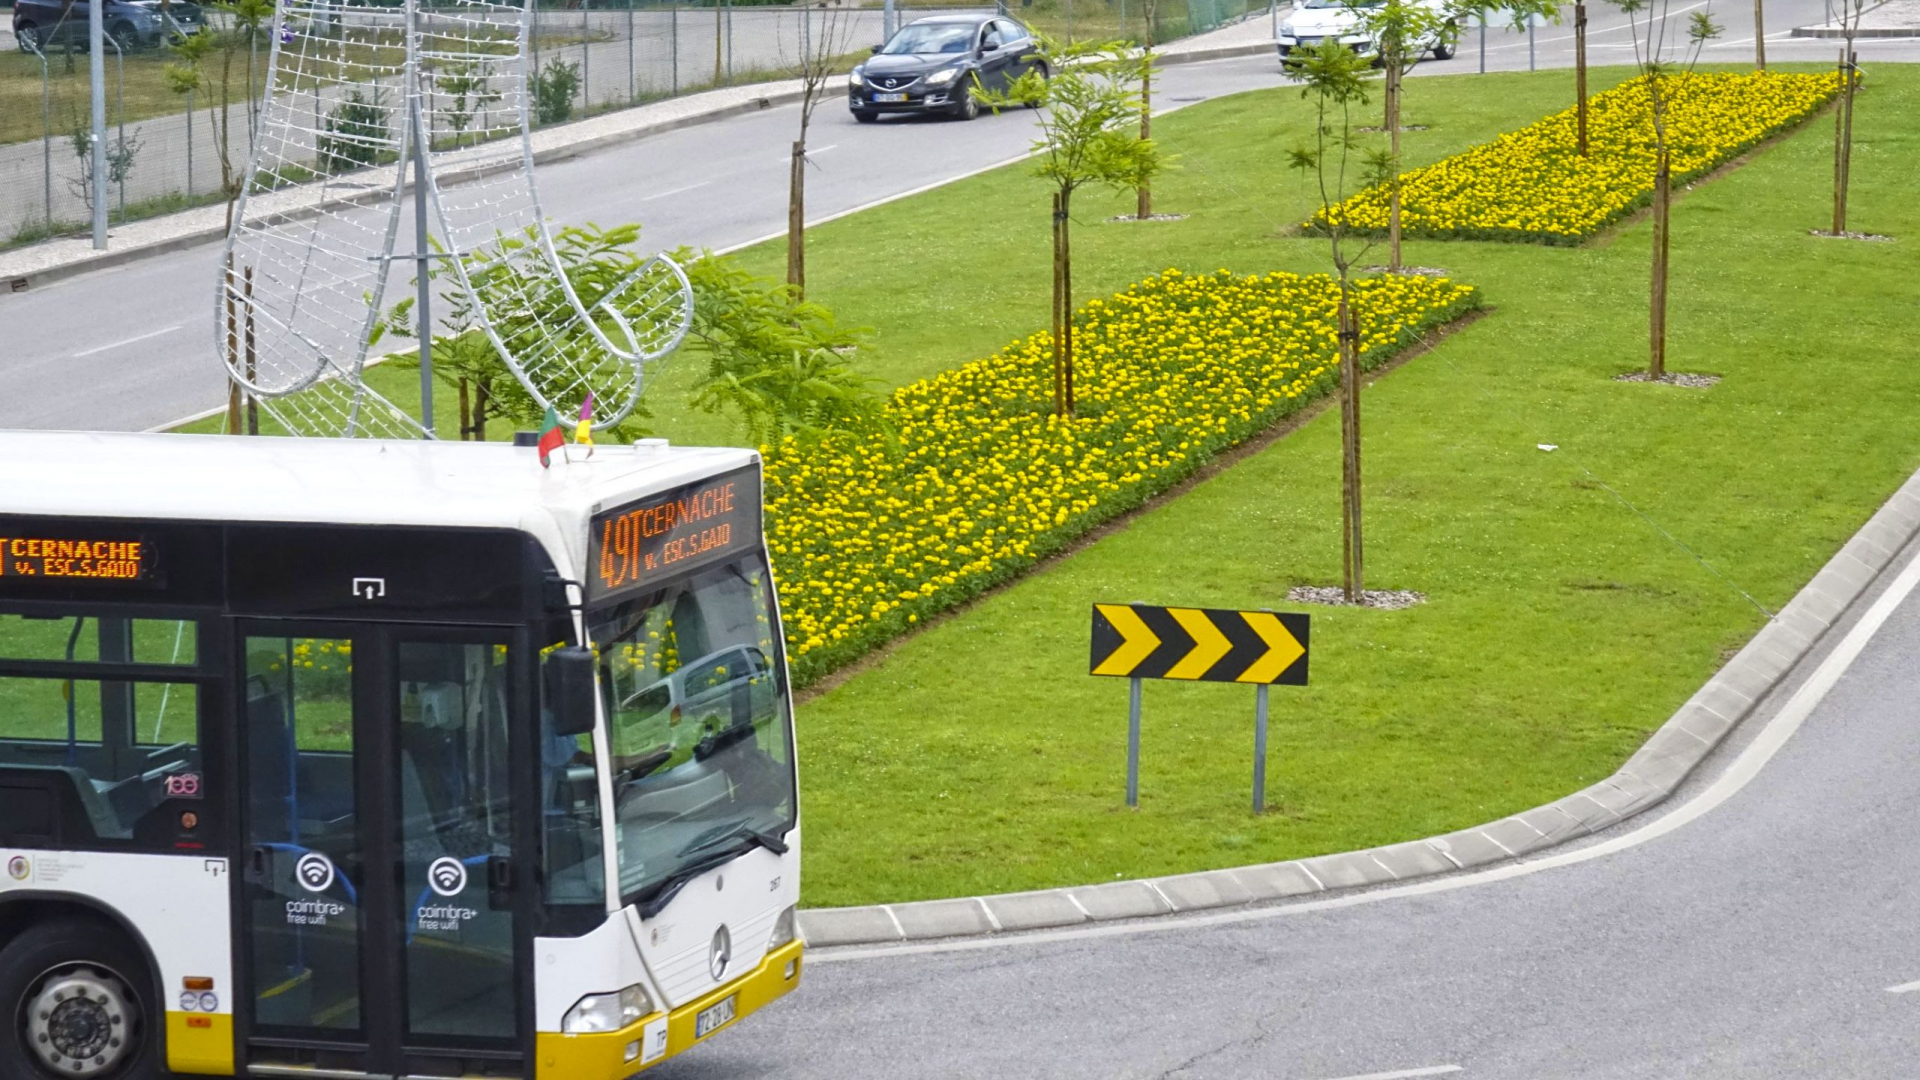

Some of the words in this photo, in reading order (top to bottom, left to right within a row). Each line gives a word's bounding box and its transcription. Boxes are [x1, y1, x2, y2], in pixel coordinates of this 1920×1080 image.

[600, 509, 643, 588] 49T
[642, 482, 735, 538] CERNACHE
[11, 539, 141, 560] CERNACHE
[44, 558, 138, 578] ESC.S.GAIO
[287, 912, 306, 924] free
[308, 914, 326, 925] wifi
[419, 917, 438, 930] free
[440, 919, 459, 930] wifi
